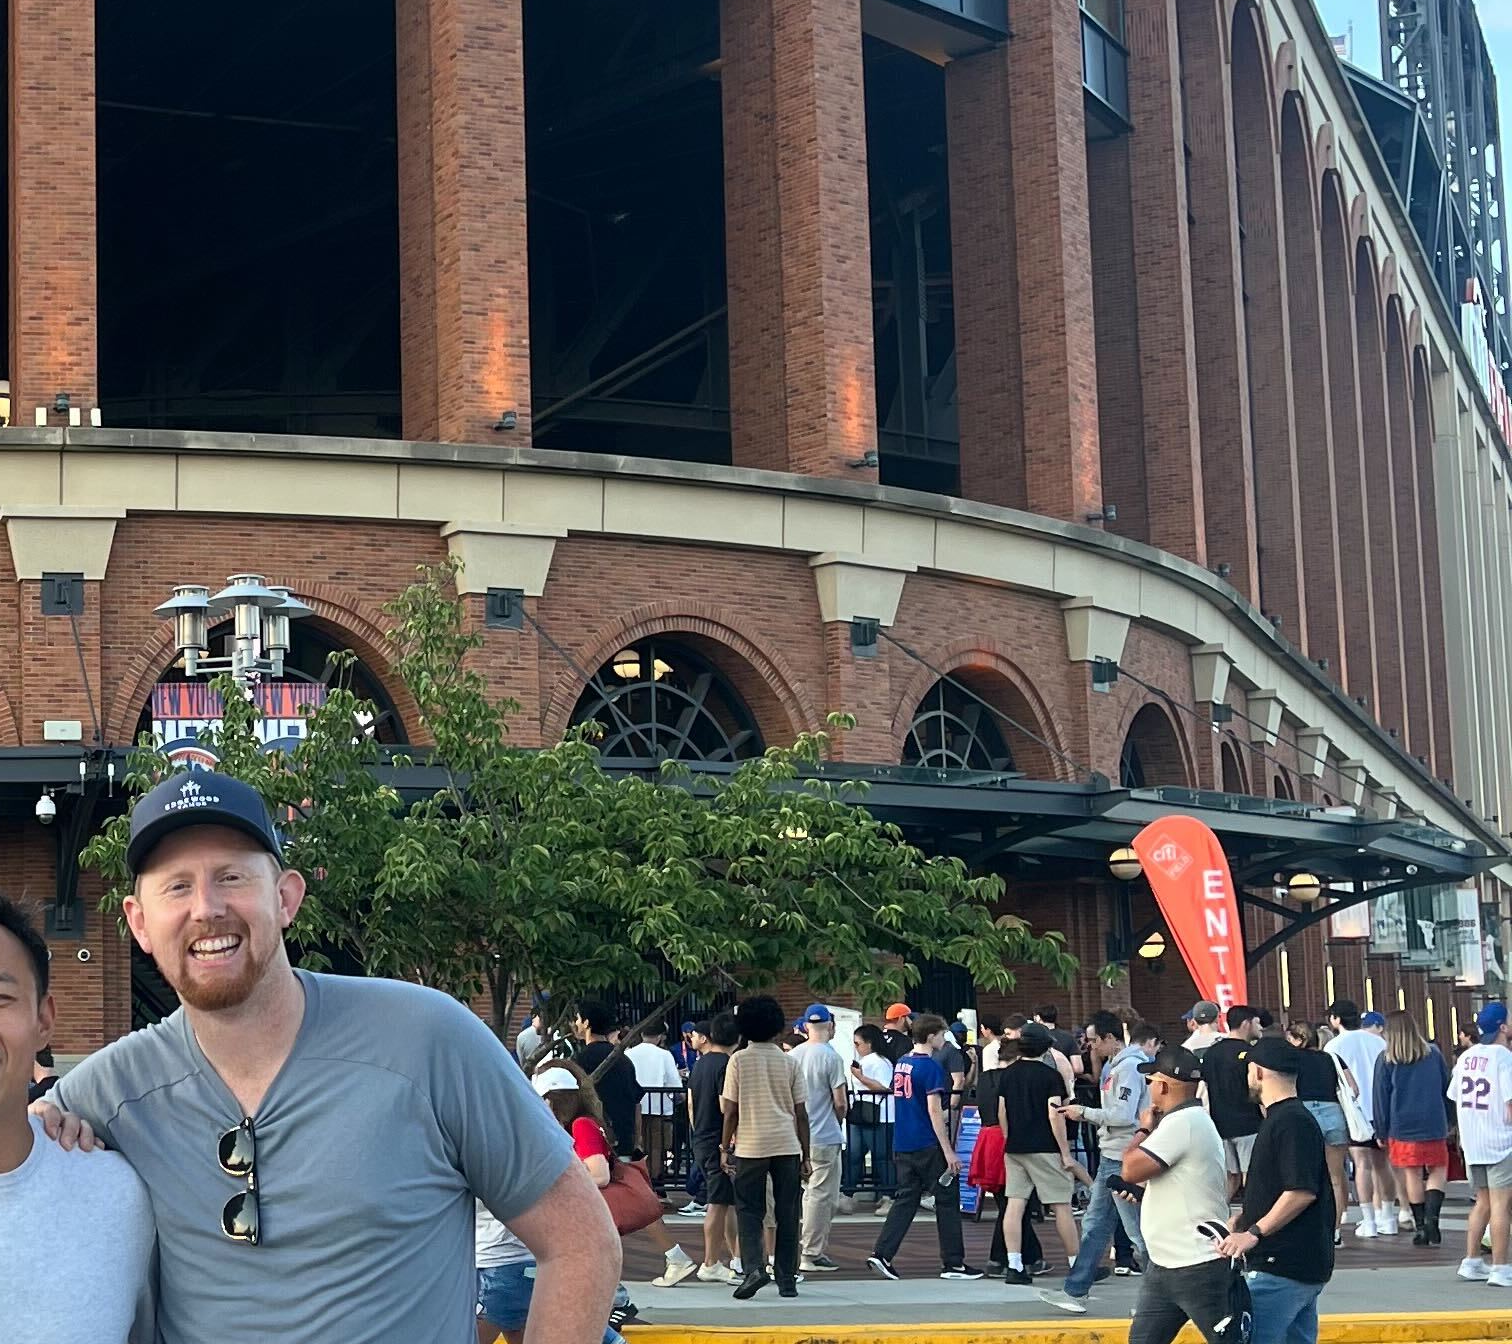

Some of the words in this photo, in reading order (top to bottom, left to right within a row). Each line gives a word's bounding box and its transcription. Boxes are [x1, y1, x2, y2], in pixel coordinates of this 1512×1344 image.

[1202, 869, 1235, 1014] ENTE
[893, 1072, 913, 1099] 20
[1461, 1076, 1491, 1110] 22
